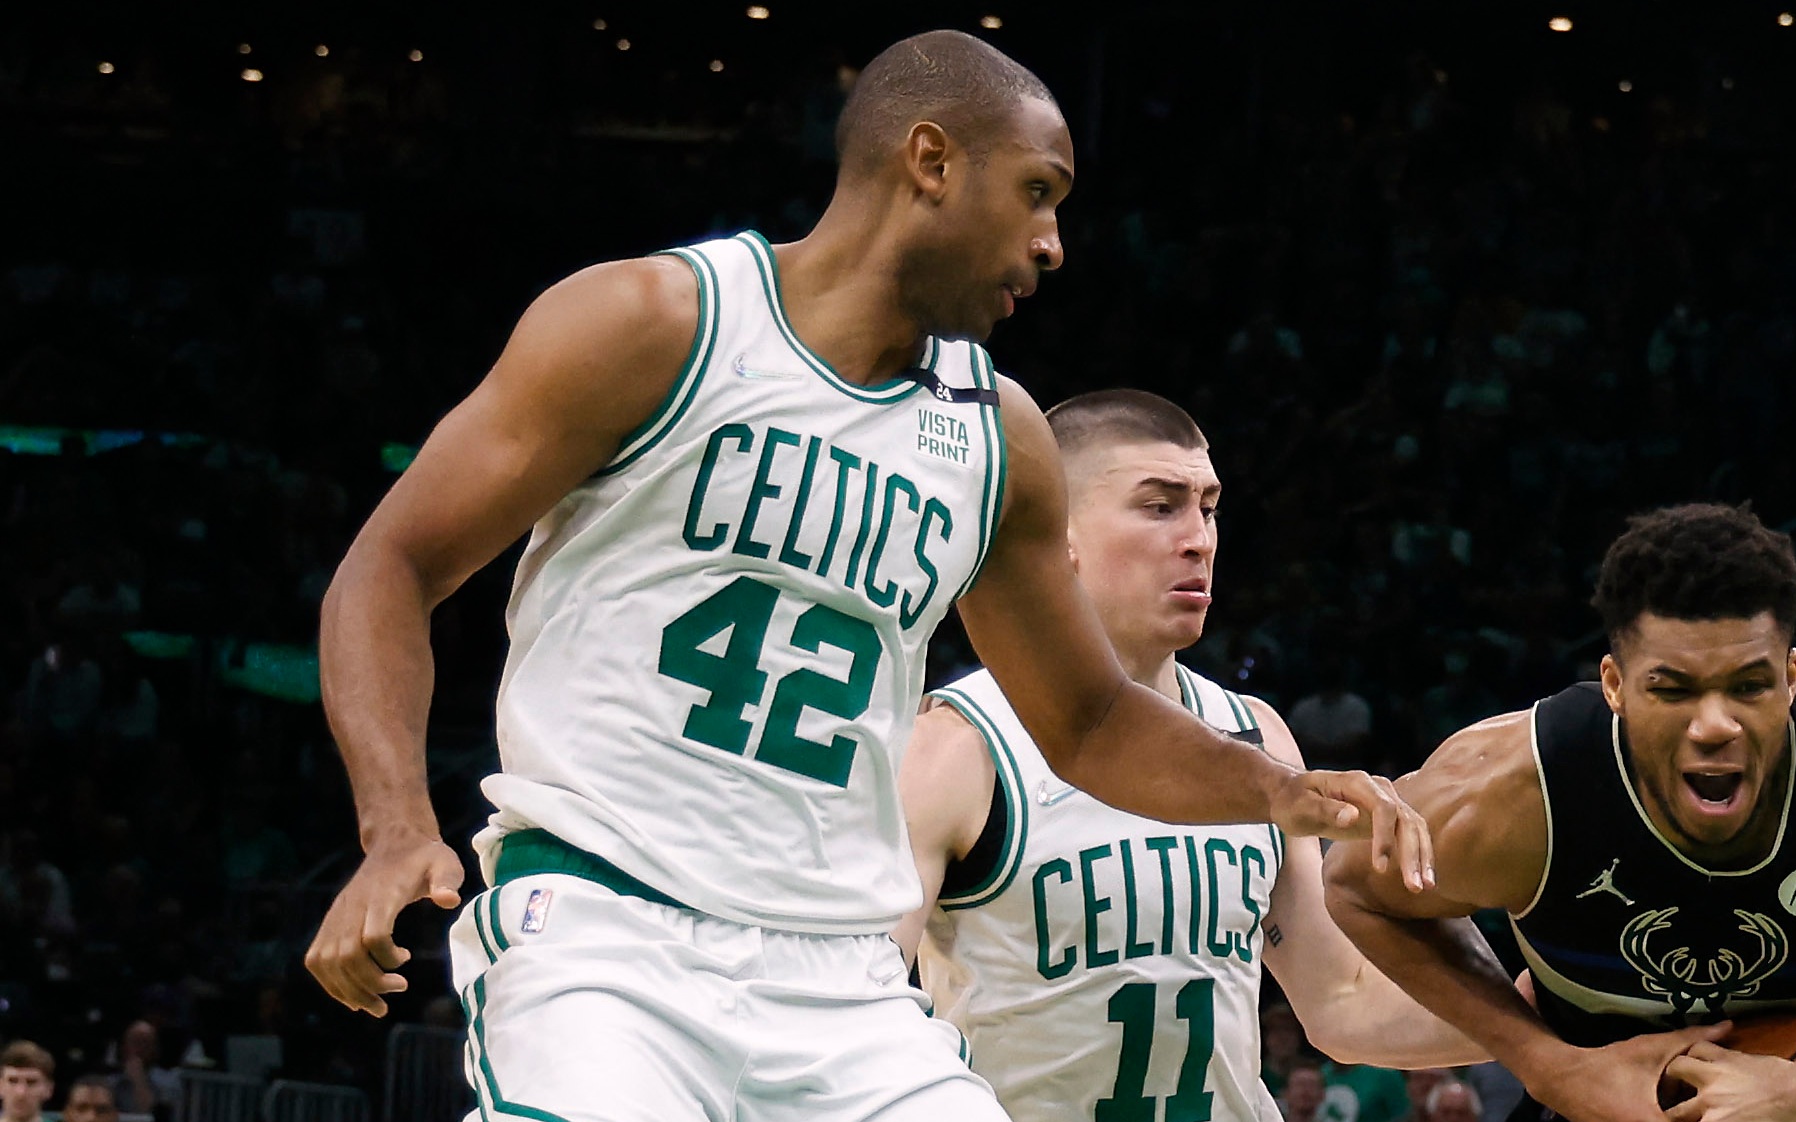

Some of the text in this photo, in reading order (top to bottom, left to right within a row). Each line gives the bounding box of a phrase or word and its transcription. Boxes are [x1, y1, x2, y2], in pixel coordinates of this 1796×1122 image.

[918, 408, 970, 446] VISTA
[936, 382, 953, 402] 24
[917, 433, 970, 464] PRINT
[682, 422, 954, 631] CELTICS
[658, 575, 883, 788] 42
[1032, 835, 1266, 980] CELTICS
